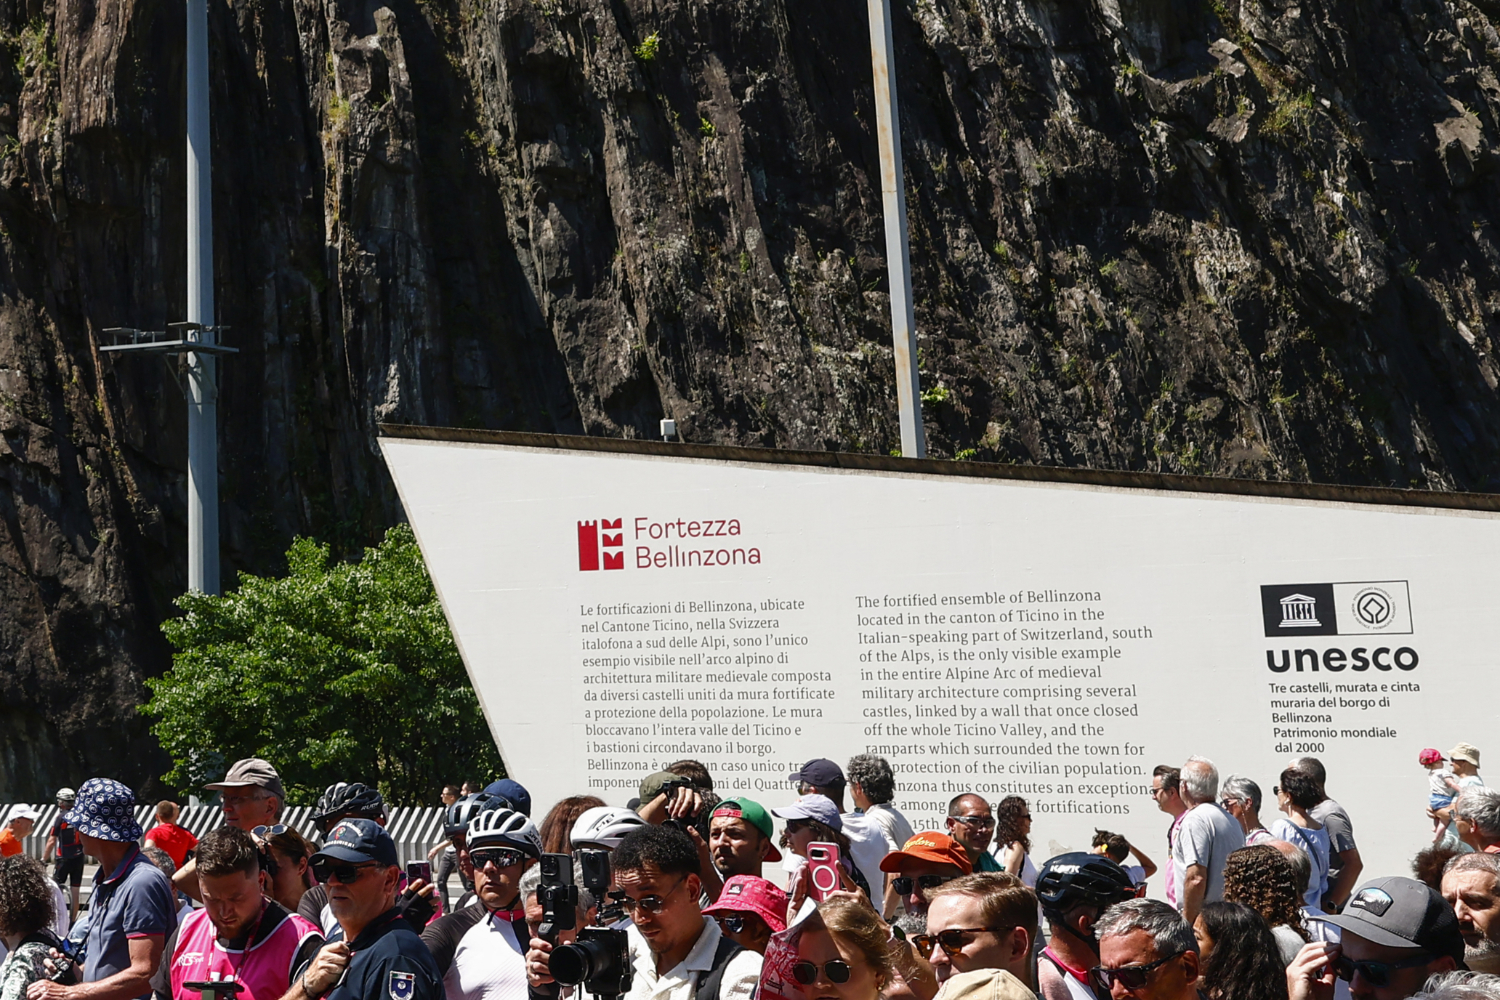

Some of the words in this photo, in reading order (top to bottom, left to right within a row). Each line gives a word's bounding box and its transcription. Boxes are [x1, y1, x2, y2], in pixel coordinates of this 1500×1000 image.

[634, 517, 740, 540] Fortezza
[636, 544, 760, 568] Bellinzona
[856, 596, 879, 608] The
[884, 594, 936, 606] fortified
[941, 592, 1005, 605] ensemble
[1010, 591, 1022, 603] of
[1028, 590, 1100, 602] Bellinzona
[581, 605, 593, 615] Le
[597, 602, 670, 615] fortificazioni
[675, 602, 685, 613] di
[690, 601, 756, 613] Bellinzona,
[761, 599, 804, 610] ubicate
[858, 613, 903, 626] located
[908, 613, 920, 624] in
[925, 612, 945, 624] the
[950, 614, 995, 623] canton
[1000, 610, 1012, 622] of
[1016, 609, 1059, 621] Ticino
[1064, 609, 1076, 620] in
[1082, 608, 1104, 620] the
[582, 622, 598, 632] nel
[602, 622, 649, 632] Cantone
[653, 620, 692, 632] Ticino,
[697, 618, 725, 630] nella
[730, 618, 779, 628] Svizzera
[583, 638, 632, 649] italofona
[646, 637, 665, 648] sud
[670, 636, 697, 648] delle
[701, 636, 729, 650] Alpi,
[734, 638, 762, 646] sono
[859, 630, 968, 646] Italian-speaking
[972, 632, 999, 645] part
[1004, 628, 1016, 641] of
[1021, 627, 1108, 642] Switzerland,
[1113, 626, 1152, 639] south
[583, 655, 630, 669] esempio
[634, 654, 675, 665] visibile
[736, 652, 773, 667] alpino
[778, 652, 788, 663] di
[860, 650, 872, 662] of
[876, 650, 896, 662] the
[901, 650, 934, 664] Alps,
[939, 649, 949, 660] is
[954, 649, 974, 660] the
[979, 648, 1008, 663] only
[1012, 647, 1057, 659] visible
[1062, 646, 1121, 662] example
[1266, 646, 1419, 672] unesco
[584, 673, 651, 684] architettura
[656, 672, 702, 682] militare
[706, 670, 767, 682] medievale
[772, 672, 831, 684] composta
[861, 669, 872, 680] in
[878, 668, 898, 680] the
[902, 668, 941, 680] entire
[946, 667, 989, 682] Alpine
[994, 667, 1015, 678] Arc
[1020, 666, 1033, 678] of
[1038, 666, 1101, 678] medieval
[584, 690, 597, 700] da
[601, 690, 638, 700] diversi
[643, 689, 683, 700] castelli
[688, 689, 715, 700] uniti
[720, 689, 733, 700] da
[738, 691, 768, 699] mura
[773, 687, 834, 699] fortificate
[862, 687, 913, 701] military
[918, 686, 998, 698] architecture
[1004, 685, 1082, 700] comprising
[1086, 684, 1136, 696] several
[1269, 683, 1286, 693] Tre
[1290, 682, 1332, 696] castelli,
[1336, 683, 1377, 692] murata
[1391, 682, 1420, 692] cinta
[1271, 698, 1315, 708] muraria
[1318, 697, 1336, 707] del
[1340, 697, 1376, 710] borgo
[1379, 696, 1390, 707] di
[595, 707, 656, 721] protezione
[660, 706, 687, 717] della
[692, 706, 768, 720] popolazione.
[773, 706, 786, 717] Le
[791, 709, 822, 717] mura
[863, 705, 911, 719] castles,
[916, 705, 956, 716] linked
[961, 705, 976, 720] by
[992, 704, 1019, 716] wall
[1024, 704, 1052, 716] that
[1057, 707, 1089, 716] once
[1094, 704, 1138, 716] closed
[1272, 712, 1332, 723] Bellinzona
[586, 724, 649, 735] bloccavano
[700, 724, 728, 735] valle
[732, 724, 749, 735] del
[753, 724, 791, 735] Ticino
[864, 723, 882, 735] off
[887, 724, 907, 735] the
[911, 724, 950, 735] whole
[954, 724, 996, 735] Ticino
[1000, 723, 1046, 738] Valley,
[1052, 723, 1076, 735] and
[1082, 723, 1104, 735] the
[1274, 728, 1337, 738] Patrimonio
[1341, 727, 1396, 738] mondiale
[594, 742, 639, 752] bastioni
[643, 742, 722, 753] circondavano
[726, 742, 732, 753] il
[737, 742, 775, 756] borgo.
[866, 744, 925, 757] ramparts
[929, 742, 969, 754] which
[974, 742, 1052, 754] surrounded
[1058, 742, 1079, 754] the
[1085, 745, 1119, 755] town
[1124, 742, 1144, 755] for
[1275, 742, 1292, 752] dal
[1296, 743, 1324, 752] 2000
[587, 759, 648, 770] Bellinzona
[721, 762, 748, 771] caso
[752, 760, 785, 772] unico
[892, 761, 960, 776] protection
[965, 761, 978, 773] of
[983, 762, 1004, 773] the
[1009, 762, 1059, 774] civilian
[1064, 762, 1146, 778] population.
[942, 780, 971, 792] thus
[975, 780, 1052, 793] constitutes
[900, 800, 946, 814] among
[1036, 799, 1130, 814] fortifications
